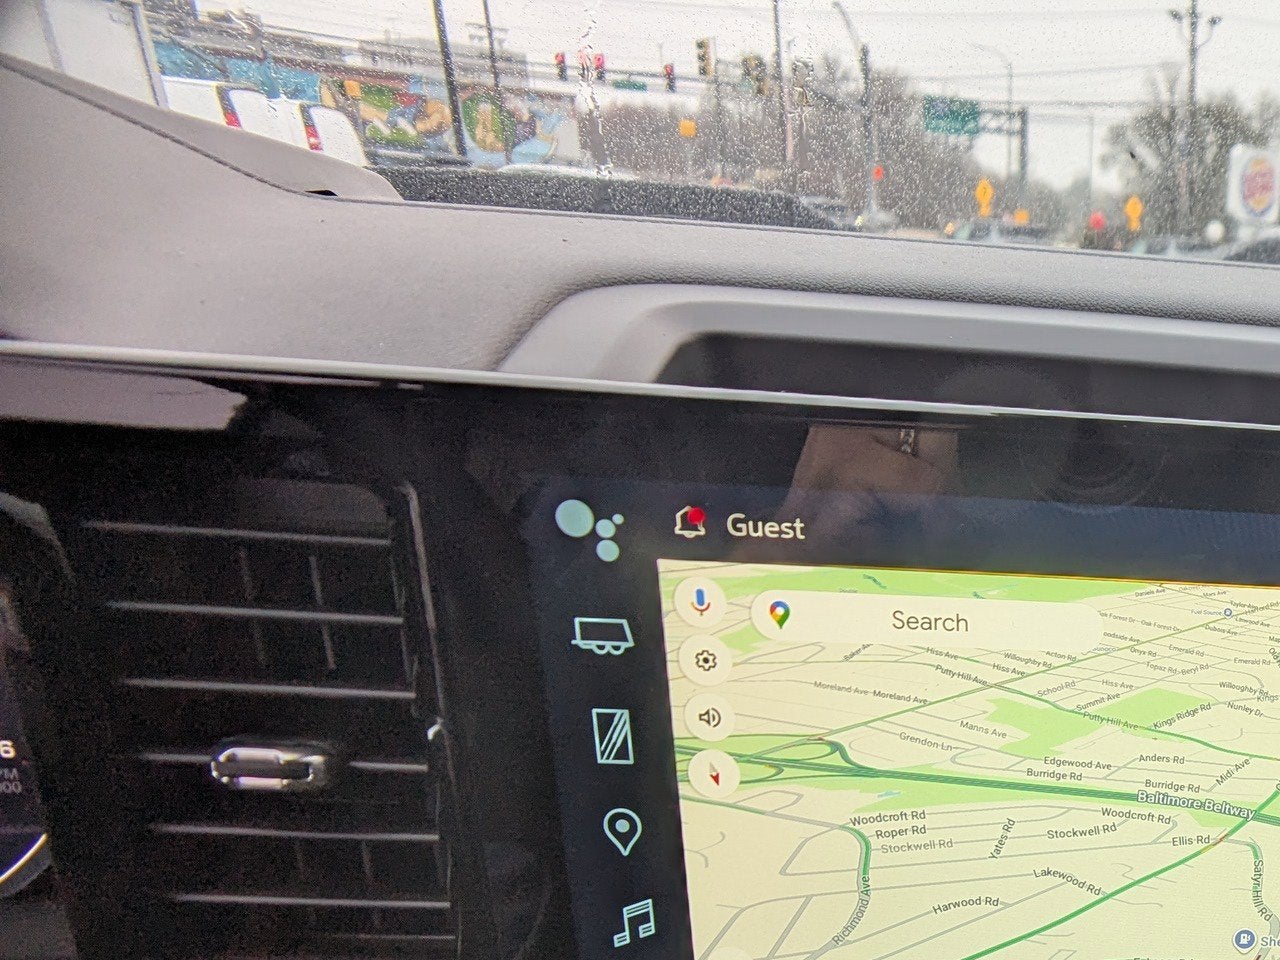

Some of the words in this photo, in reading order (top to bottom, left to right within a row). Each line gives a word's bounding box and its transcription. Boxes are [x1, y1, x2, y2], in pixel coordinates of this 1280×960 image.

[726, 513, 806, 540] Guest
[891, 610, 969, 633] Search
[935, 663, 957, 679] Putty
[957, 671, 971, 681] Hill
[972, 675, 988, 687] Ave
[814, 681, 851, 692] Moreland
[853, 687, 868, 696] Ave
[873, 690, 911, 703] Moreland
[913, 696, 928, 705] Ave
[1153, 714, 1175, 729] Kings
[1175, 705, 1200, 722] Ridge
[1200, 702, 1212, 713] Rd
[1227, 702, 1254, 716] Nunley
[1254, 708, 1264, 718] Dr
[959, 721, 989, 735] Manns
[991, 729, 1007, 739] Ave
[899, 731, 940, 748] Grendon
[941, 741, 953, 751] Ln
[1044, 757, 1094, 769] Edgewood
[1094, 761, 1112, 770] Ave
[1138, 754, 1170, 763] Anders
[1172, 755, 1185, 765] Rd
[1026, 768, 1067, 780] Burridge
[1069, 771, 1082, 782] Rd
[1216, 767, 1236, 786] Midi
[1232, 757, 1250, 773] Ave
[1145, 779, 1186, 792] Burridge
[1187, 783, 1200, 793] Rd
[1137, 790, 1203, 809] Baltimore
[1204, 800, 1256, 821] Beltway
[850, 812, 909, 827] Woodcroft
[911, 810, 926, 821] Rd
[1101, 807, 1157, 823] Woodcroft
[1158, 814, 1171, 825] Rd
[875, 827, 908, 840] Roper
[911, 824, 927, 835] Rd
[988, 834, 1008, 860] Yates
[1003, 817, 1016, 834] Rd
[1047, 826, 1100, 840] Stockwell
[1102, 823, 1117, 834] Rd
[1171, 835, 1193, 846] Ellis
[1196, 834, 1211, 845] Rd
[880, 841, 936, 854] Stockwell
[938, 838, 953, 850] Rd
[1033, 867, 1086, 890] Lakewood
[1086, 882, 1102, 896] Rd
[1250, 859, 1264, 887] Satyr
[932, 897, 983, 915] Harwood
[984, 896, 999, 908] Rd
[1252, 889, 1264, 908] Hill
[833, 897, 869, 946] Richmond
[860, 874, 871, 897] Ave
[1257, 906, 1273, 922] Rd
